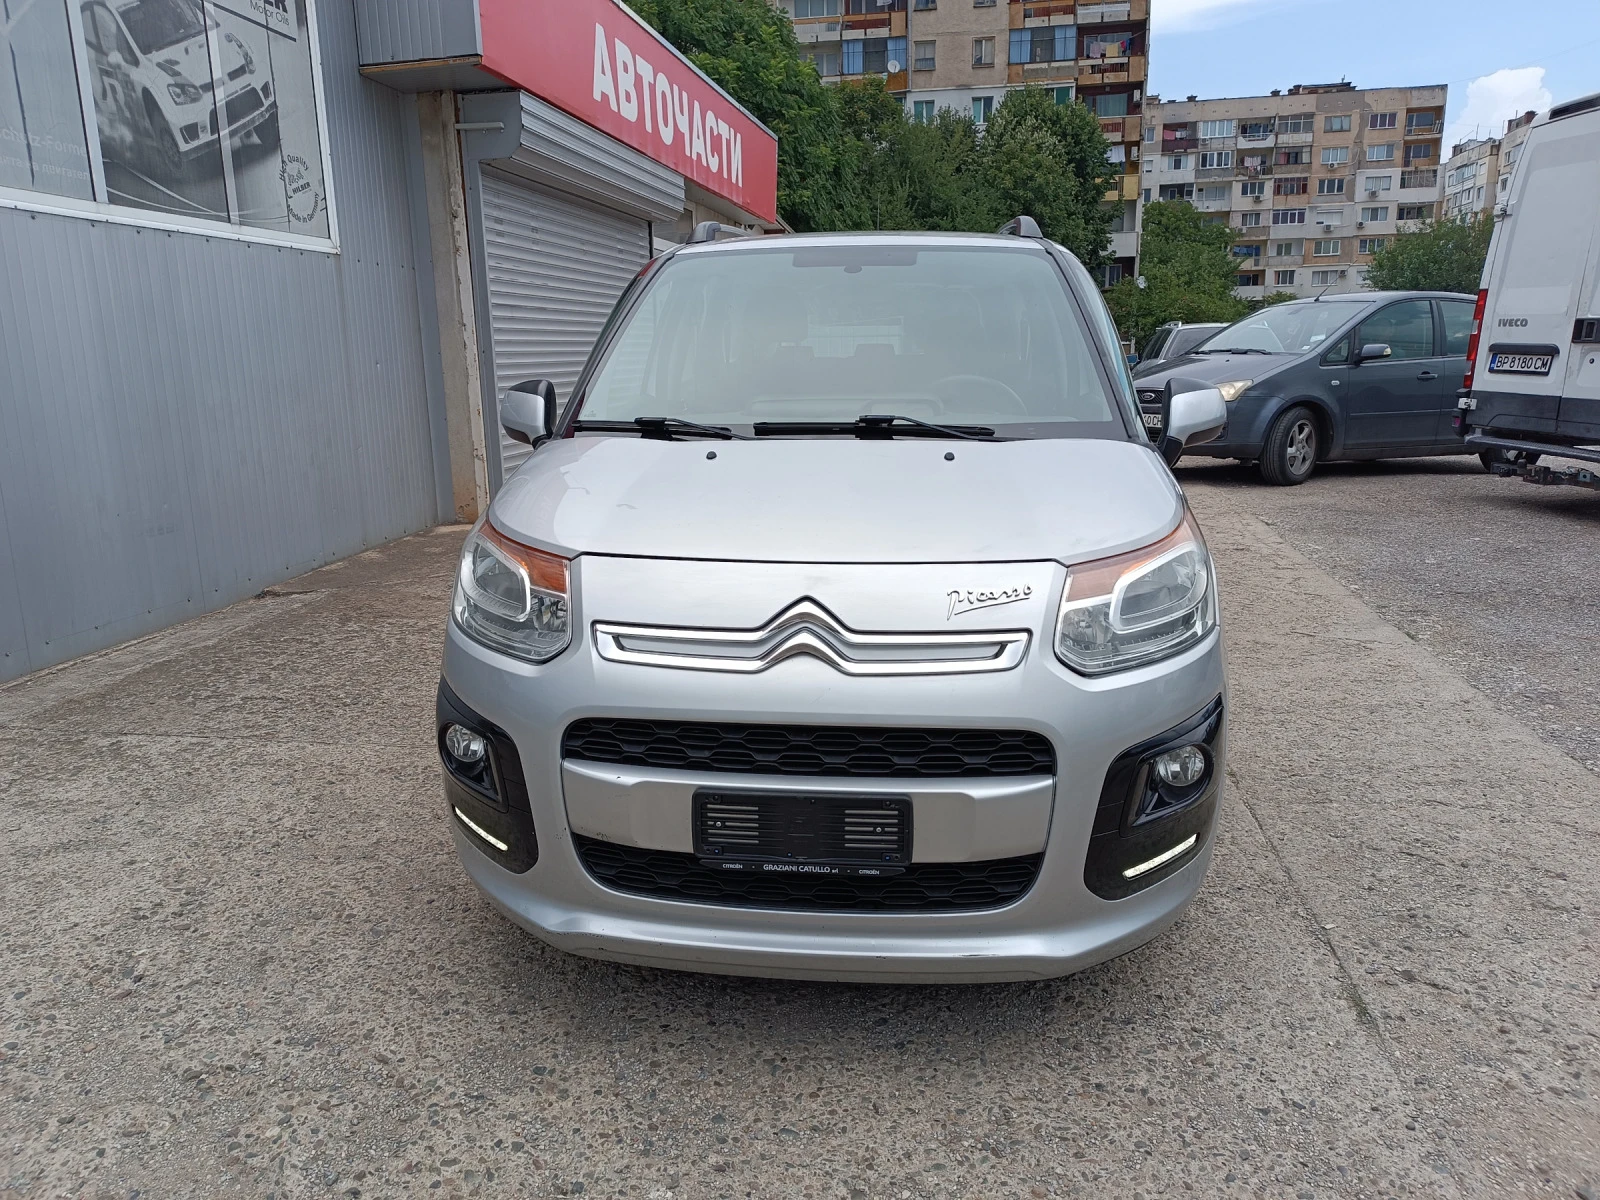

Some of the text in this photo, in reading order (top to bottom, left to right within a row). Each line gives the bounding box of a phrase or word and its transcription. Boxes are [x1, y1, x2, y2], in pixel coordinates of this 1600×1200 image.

[249, 0, 274, 19] Moor
[592, 22, 743, 188] АВТОЧАСТИ
[1497, 317, 1529, 328] IVECO
[1496, 356, 1550, 371] BP 8180 CM
[763, 864, 798, 872] GRAZIANI
[798, 865, 831, 873] CATULLO
